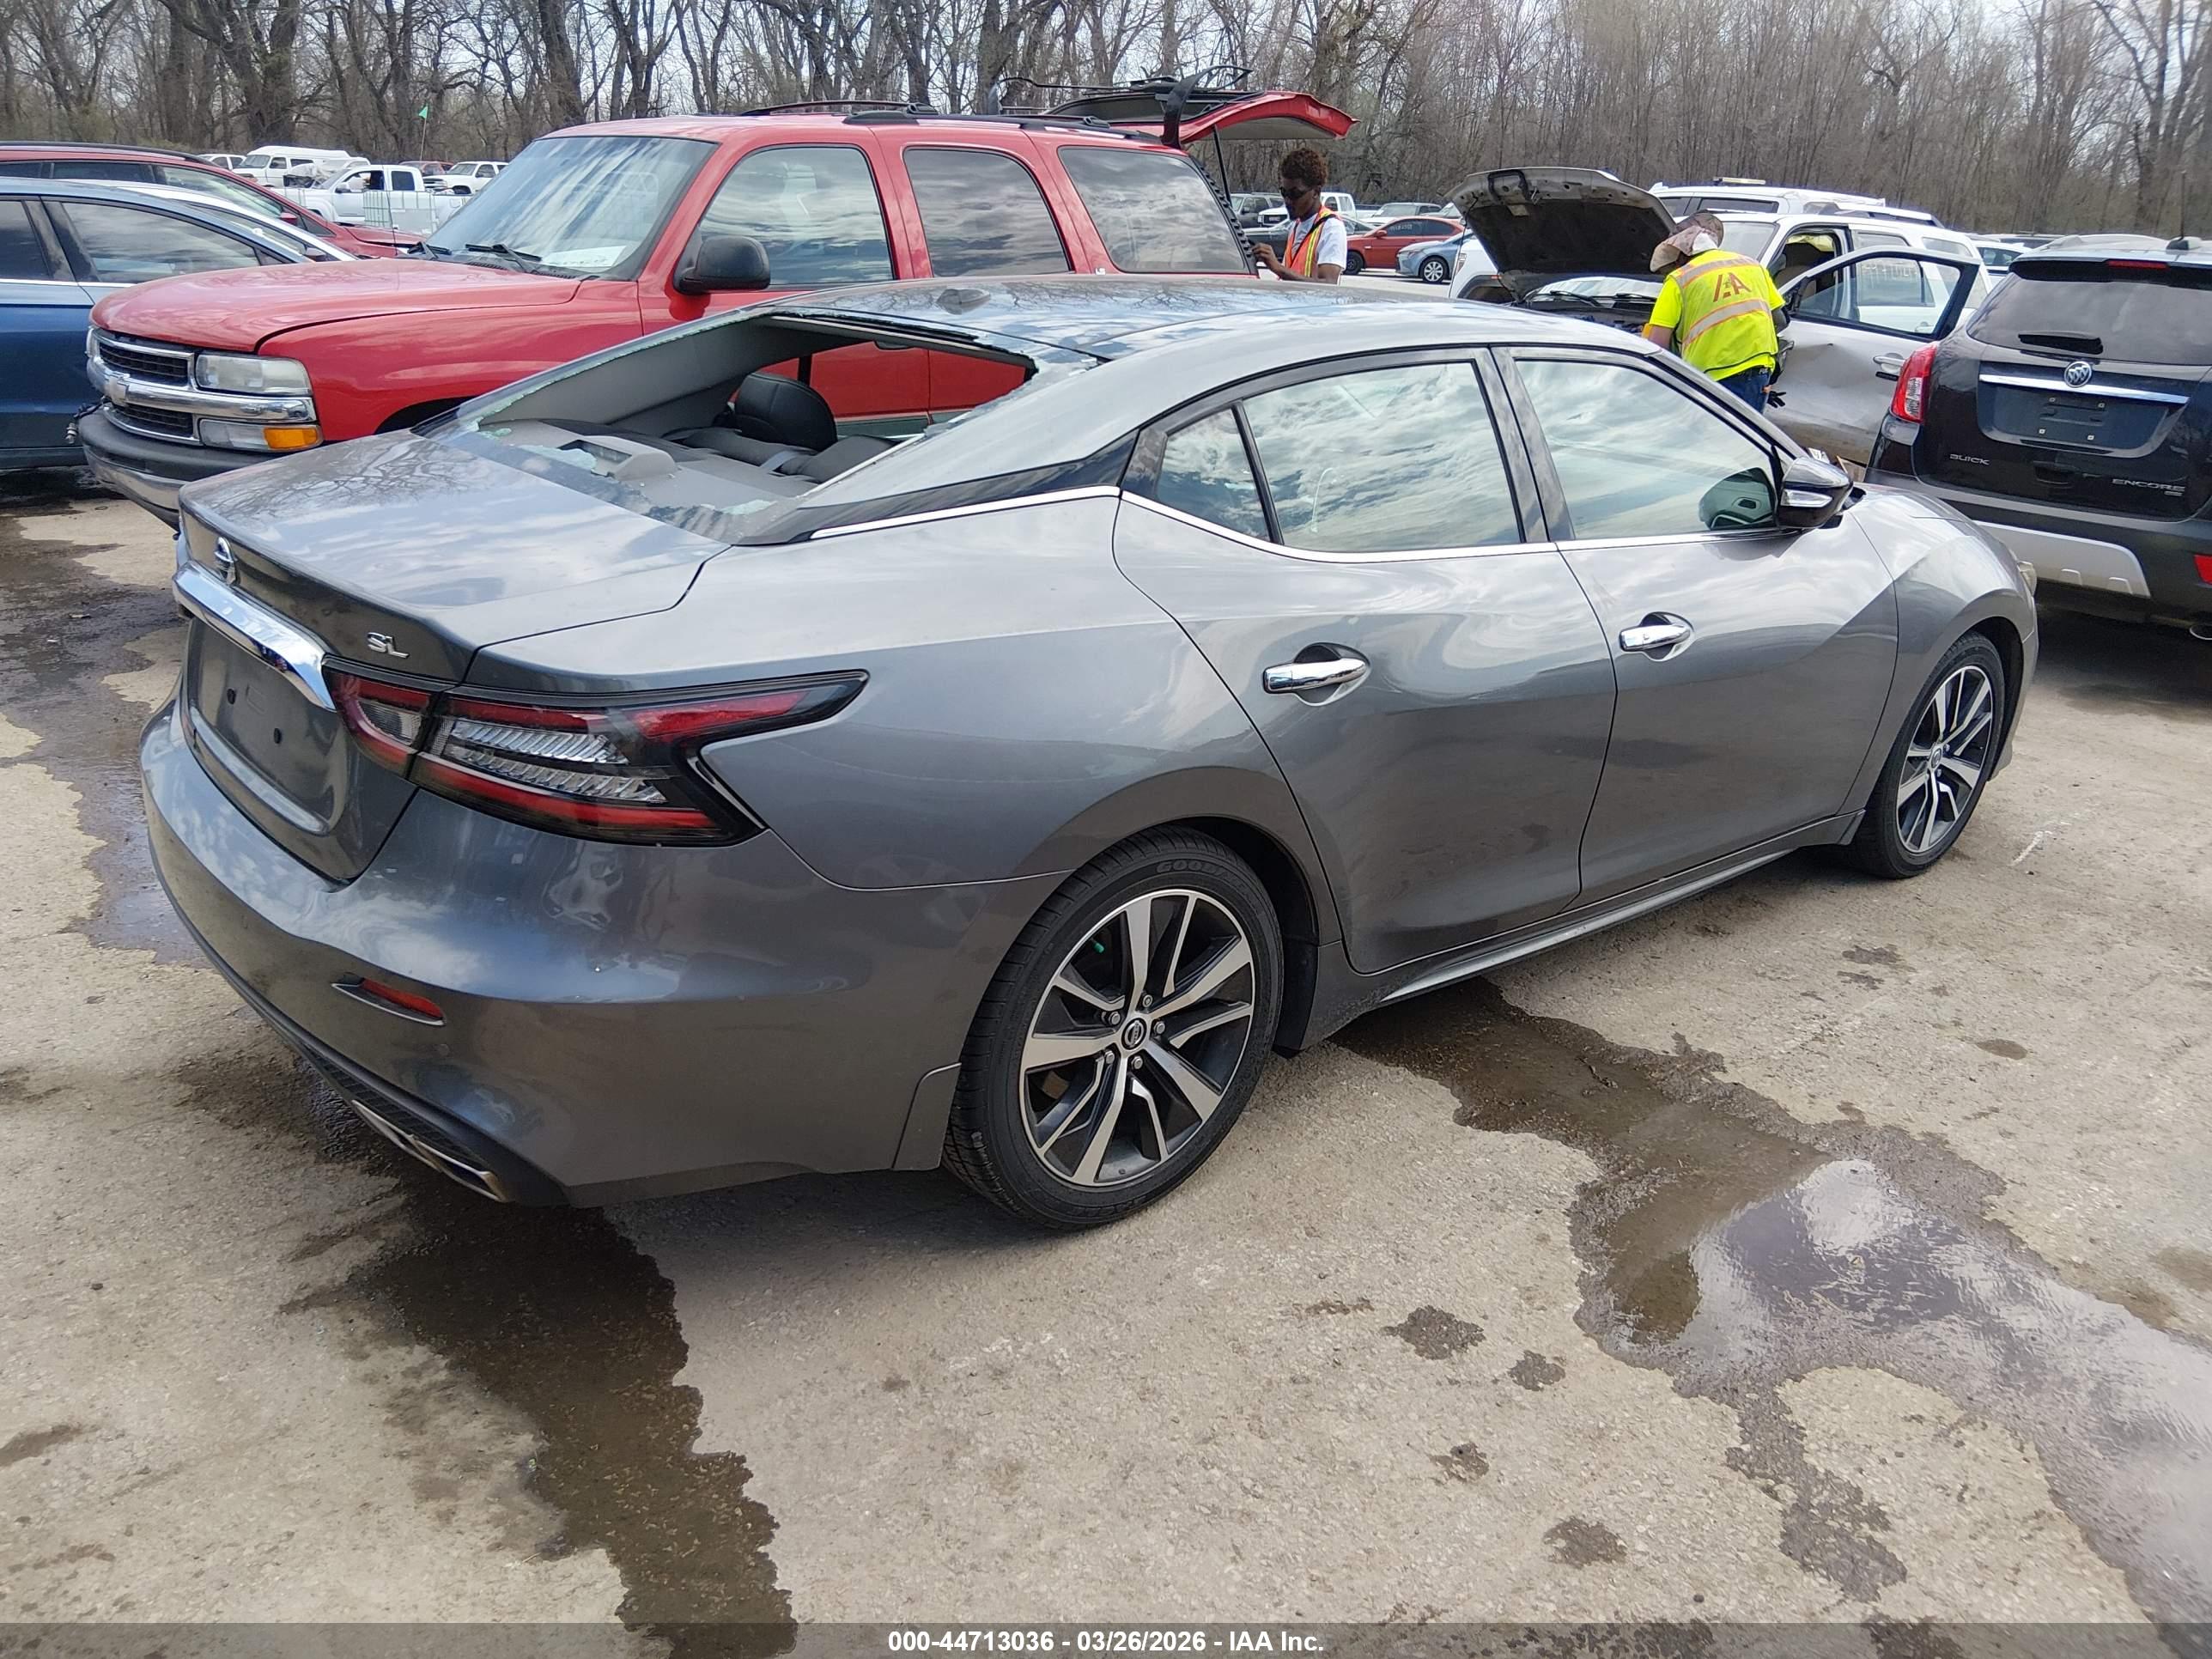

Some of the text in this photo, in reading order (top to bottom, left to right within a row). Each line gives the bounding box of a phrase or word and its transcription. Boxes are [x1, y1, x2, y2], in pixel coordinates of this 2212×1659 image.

[1949, 453, 1990, 465] BUICK
[2112, 478, 2186, 492] ENCORE
[367, 631, 410, 659] SL
